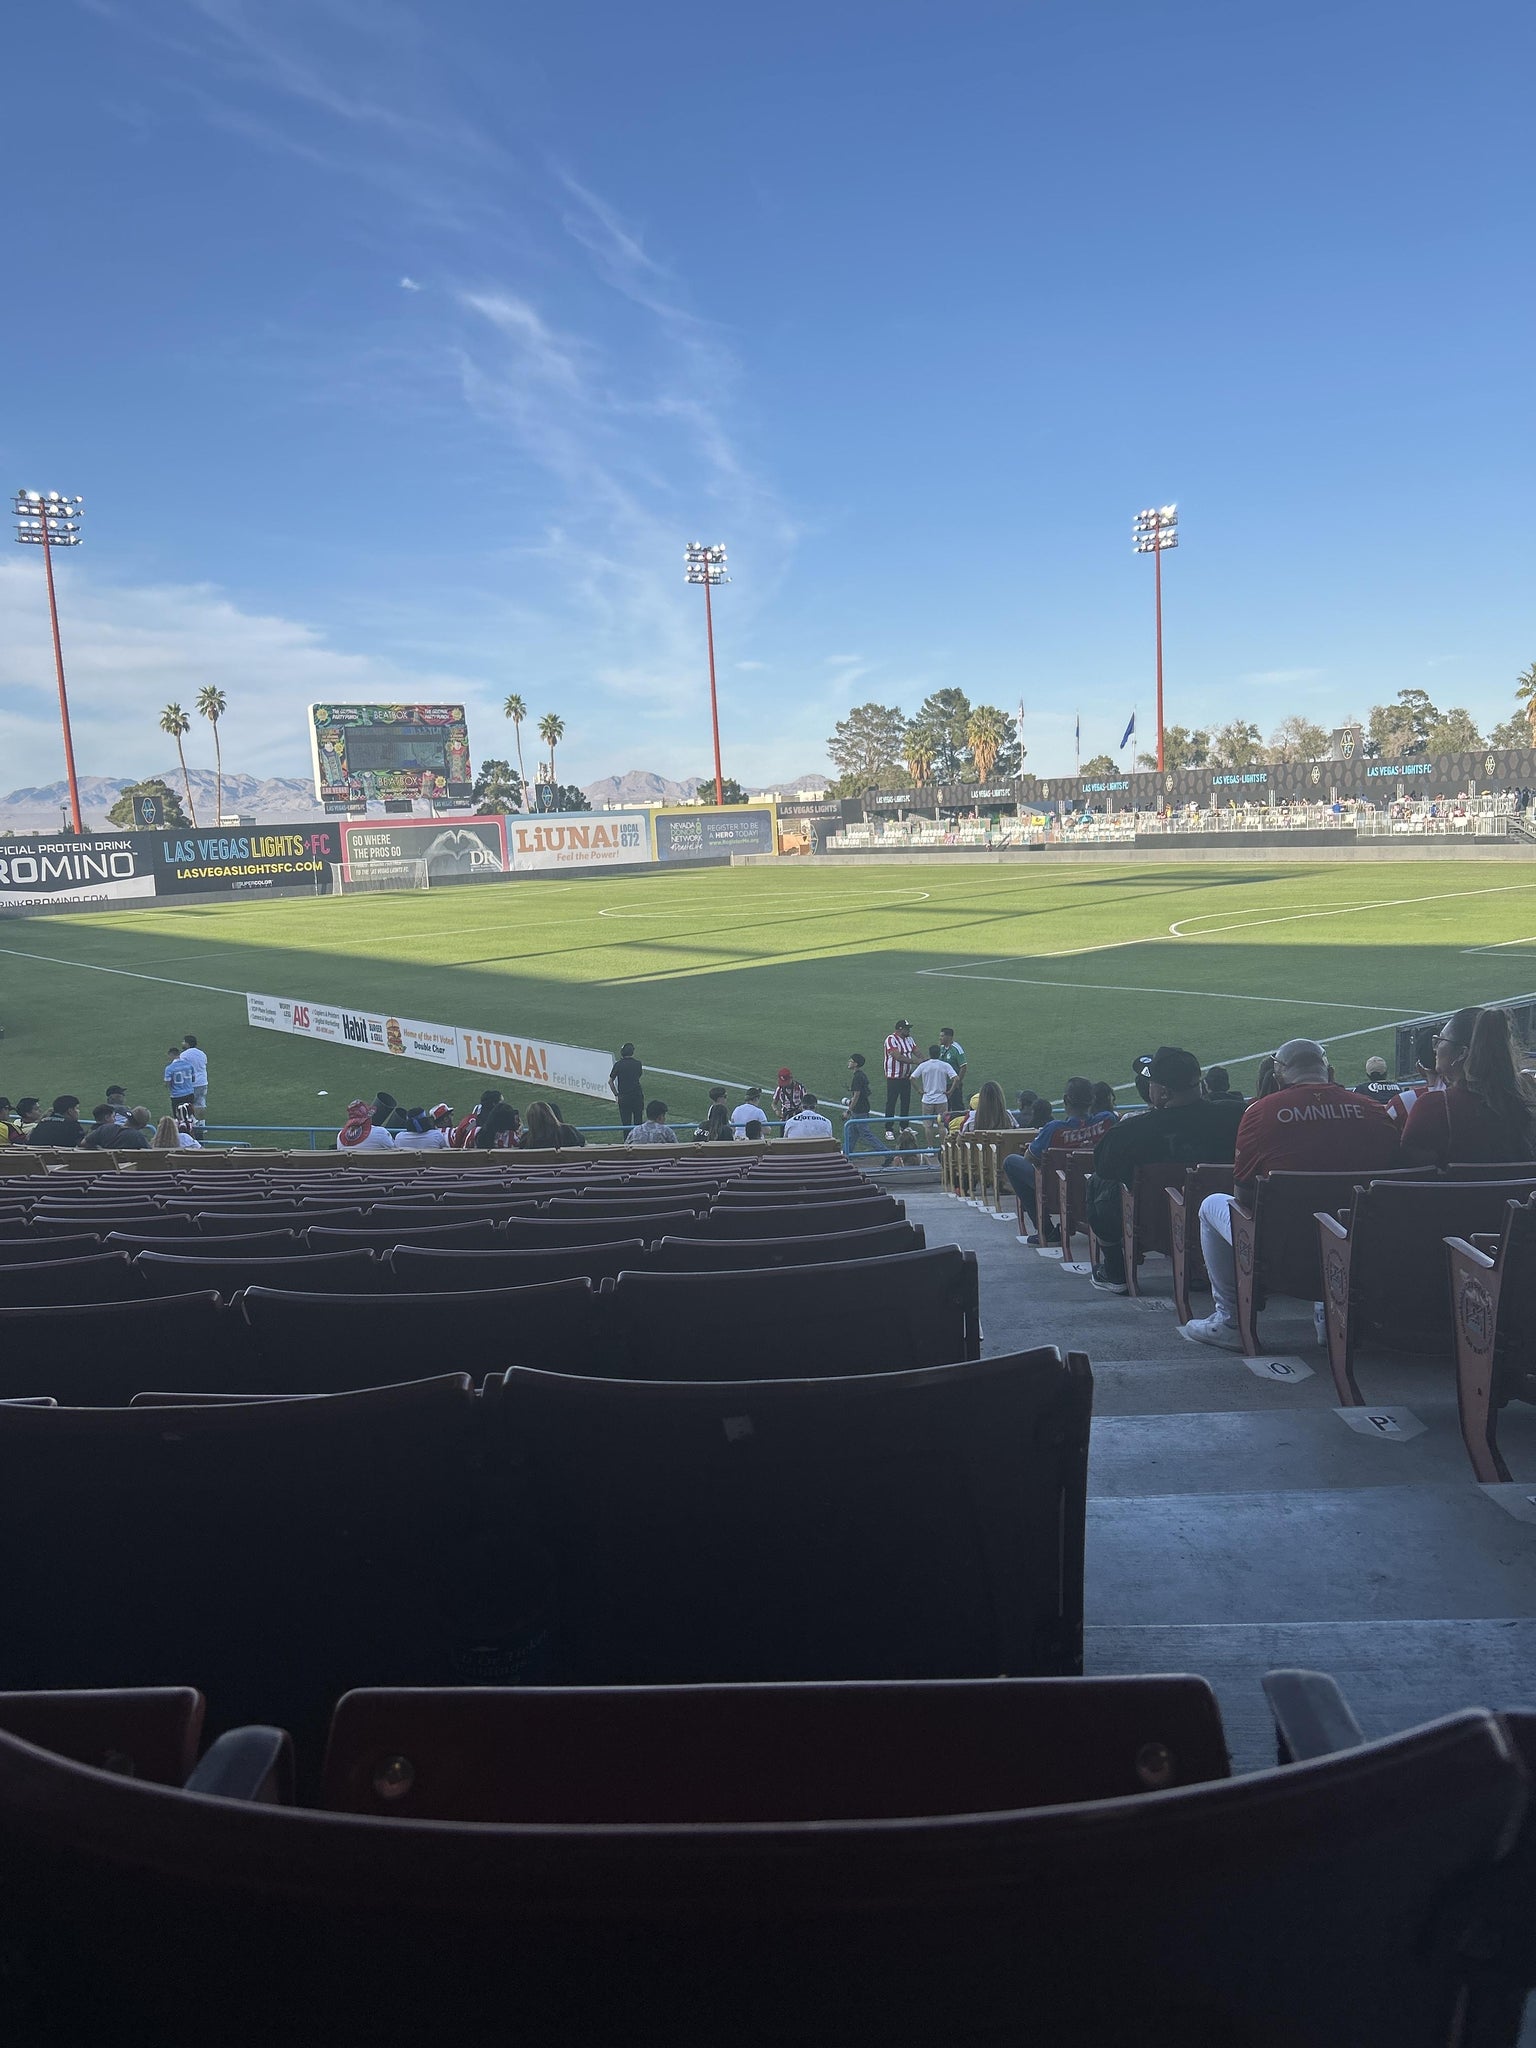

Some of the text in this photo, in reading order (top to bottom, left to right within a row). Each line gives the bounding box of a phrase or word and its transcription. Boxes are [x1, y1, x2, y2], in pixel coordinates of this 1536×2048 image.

[374, 710, 408, 720] BEATBOX
[1367, 764, 1432, 776] LAS VEGAS LIGHTS FC
[1212, 773, 1267, 785] LAS VEGAS LIGHTS FC
[1082, 784, 1091, 792] LAS
[780, 804, 838, 815] LAS VEGAS LIGHTS
[620, 824, 639, 833] LOCAL
[670, 822, 695, 830] NEVADA
[707, 823, 739, 832] REGISTER
[740, 822, 749, 830] TO
[352, 833, 391, 846] GO WHERE
[516, 824, 620, 853] LiUNA!
[621, 833, 640, 848] 872
[671, 834, 703, 843] NETWORK
[715, 831, 734, 839] HERO
[38, 842, 92, 853] PROTEIN
[95, 840, 132, 851] DRINK
[163, 833, 331, 863] LAS VEGAS LIGHTS FC
[354, 846, 401, 859] THE PROS GO
[556, 850, 619, 861] Feel the Power!
[177, 861, 323, 879] LASVEGASLIGHTSFC.COM
[293, 1005, 311, 1028] AIS
[342, 1014, 368, 1043] Habit
[403, 1028, 454, 1045] Home of the #1 Voted
[414, 1041, 445, 1054] Double Char
[463, 1035, 549, 1081] LiUNA!
[553, 1072, 608, 1093] Feel the Power!
[1277, 1104, 1364, 1123] OMNILIFE
[1062, 1120, 1105, 1144] TECATE
